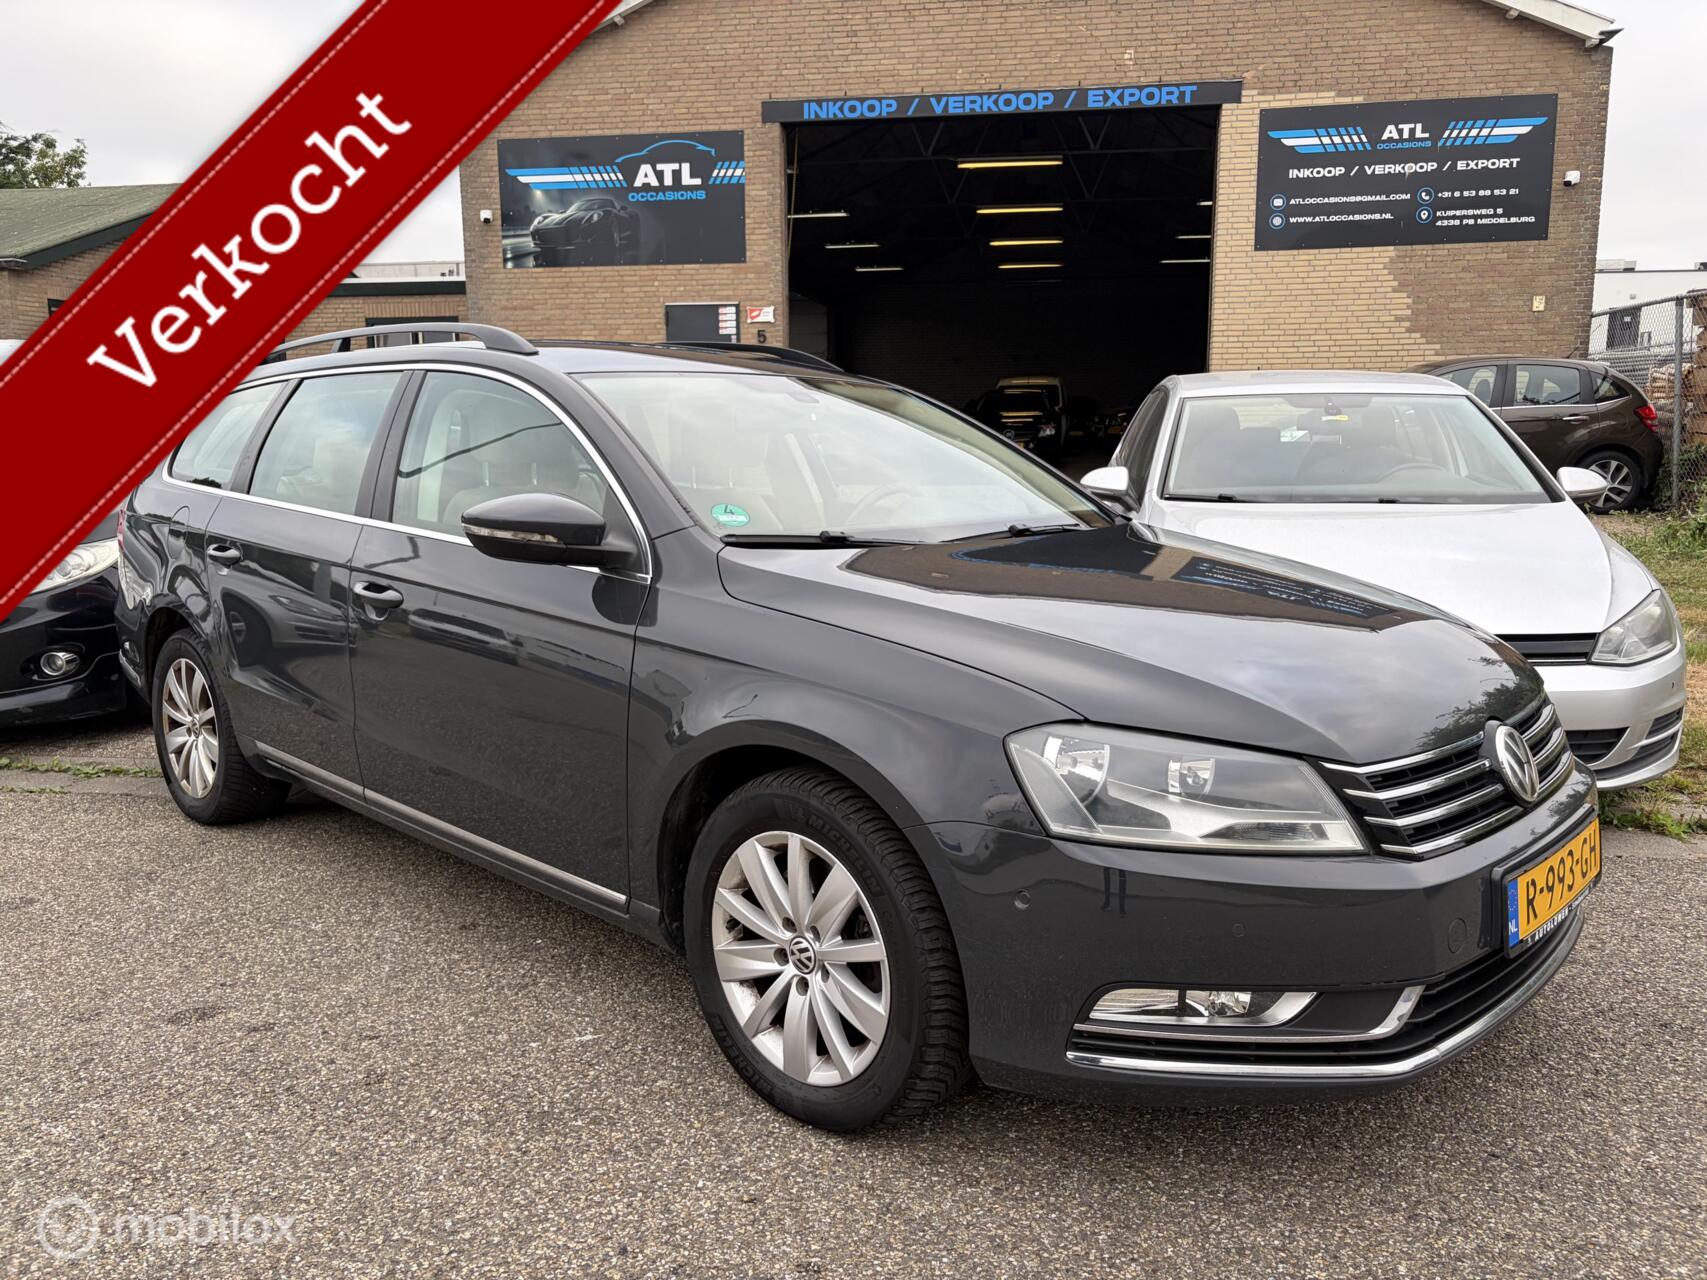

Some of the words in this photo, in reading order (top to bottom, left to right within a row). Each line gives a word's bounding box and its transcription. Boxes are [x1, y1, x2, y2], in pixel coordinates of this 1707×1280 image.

[803, 100, 897, 119] INKOOP
[930, 93, 1054, 114] VERKOOP
[1087, 85, 1197, 108] EXPORT
[1381, 123, 1430, 140] ATL
[1376, 140, 1432, 150] OCCASIONS
[633, 162, 702, 187] ATL
[1288, 166, 1346, 179] INKOOP
[1364, 161, 1438, 175] VERKOOP
[1456, 157, 1521, 170] EXPORT
[628, 190, 706, 202] OCCASIONS
[1289, 212, 1394, 223] WWW.ATLOCCASIONS.NL
[1477, 216, 1536, 225] MIDDELBURG
[757, 330, 767, 344] 5
[1526, 829, 1597, 925] R-993-GH
[1508, 919, 1518, 935] NL
